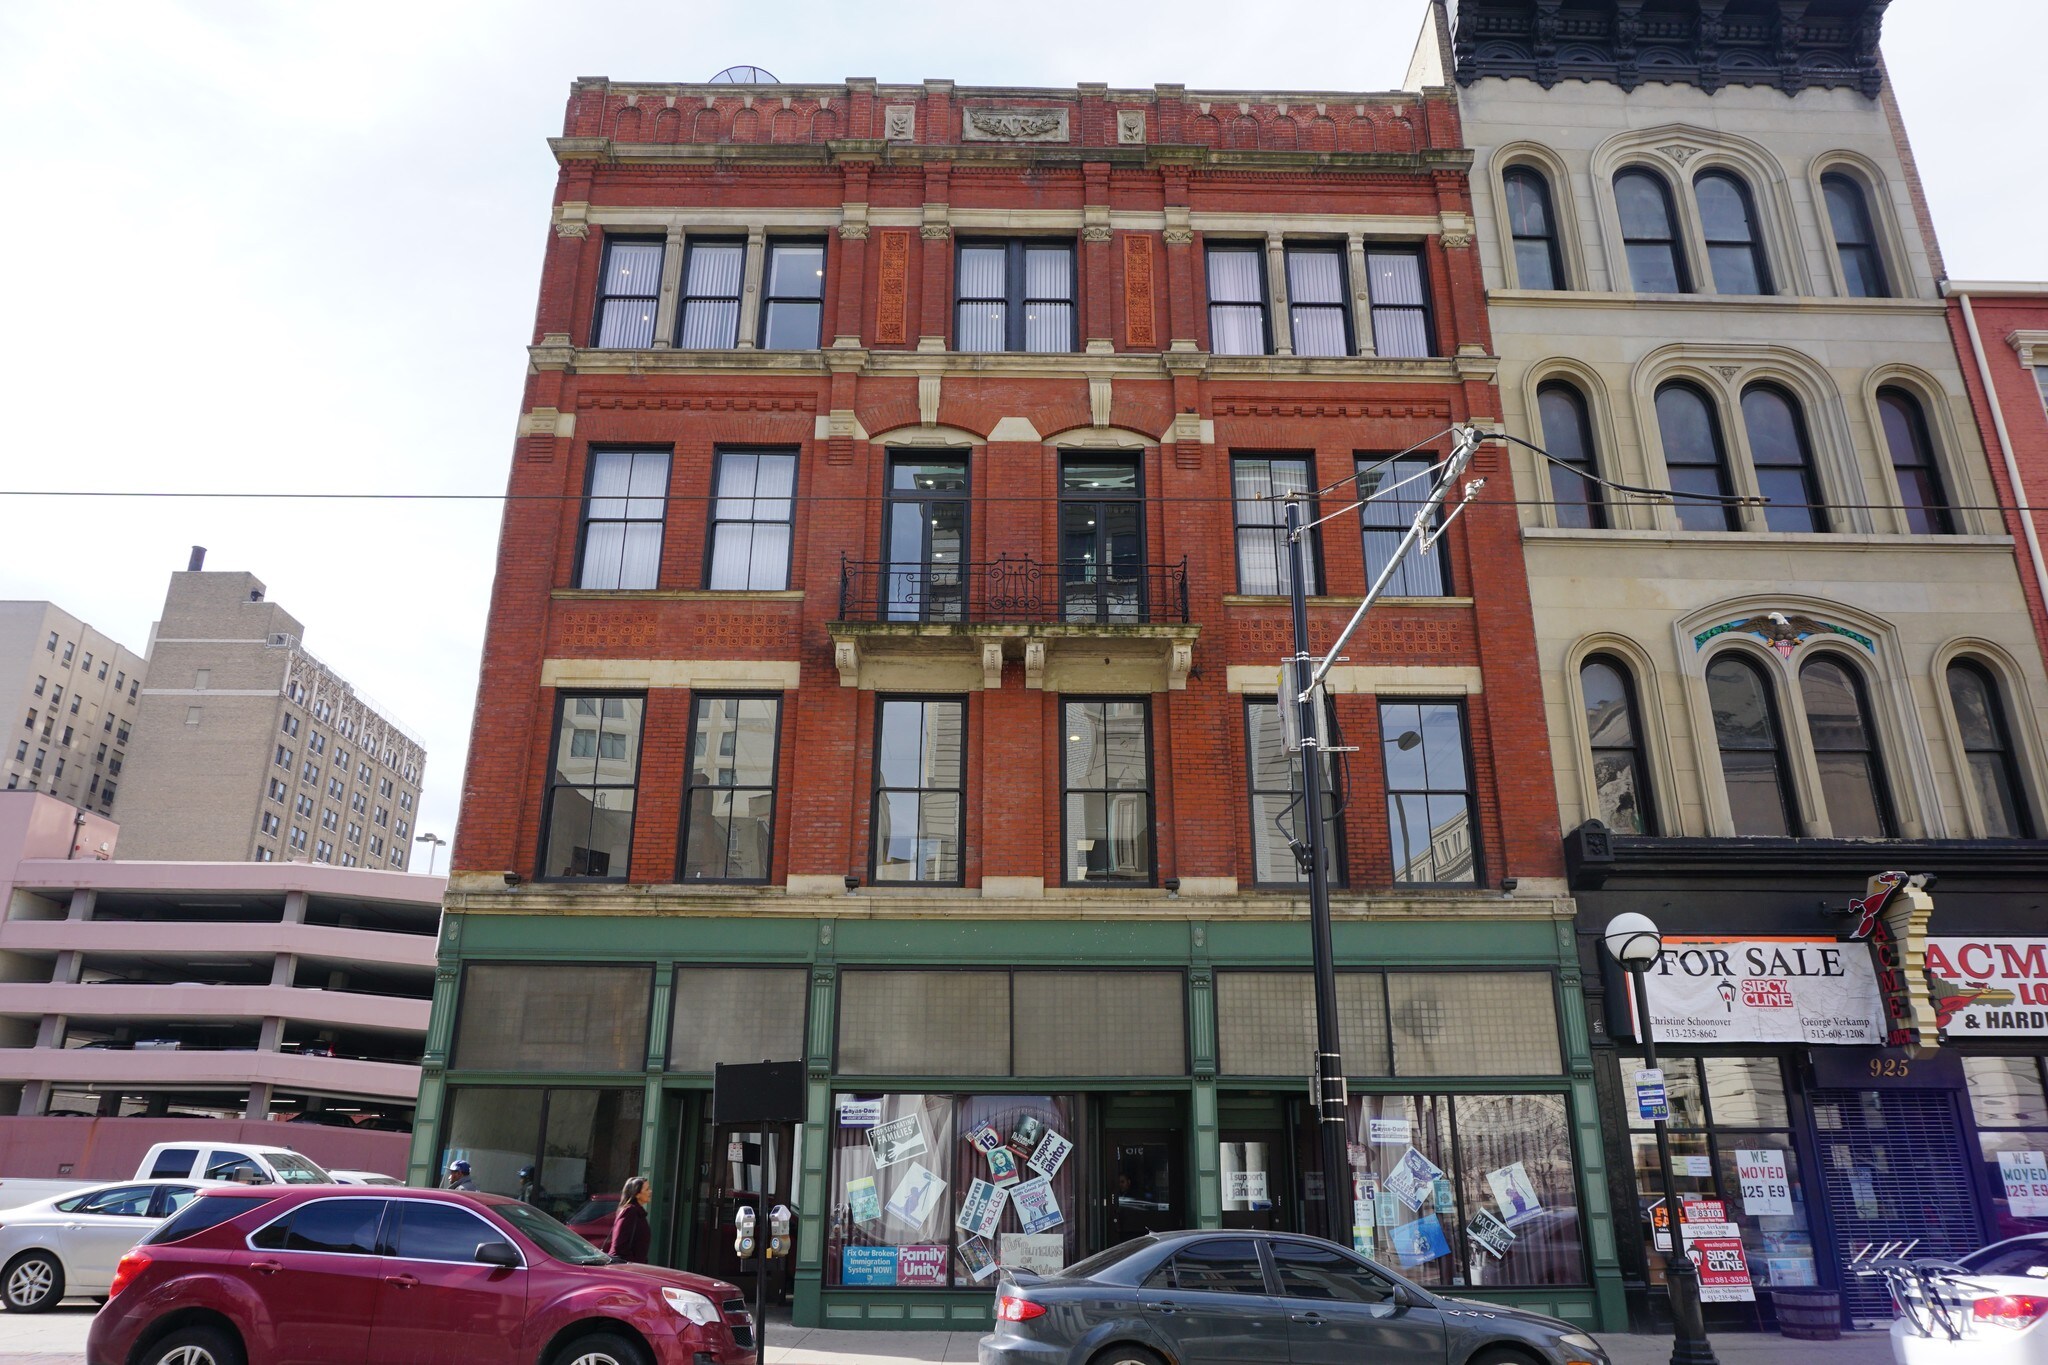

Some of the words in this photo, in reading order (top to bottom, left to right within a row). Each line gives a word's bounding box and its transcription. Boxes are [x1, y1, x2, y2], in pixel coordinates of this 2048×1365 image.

[1657, 949, 1736, 976] FOR
[1746, 948, 1845, 977] SALE
[1875, 920, 1903, 1018] ACME
[1742, 979, 1787, 993] SIBCY
[1742, 993, 1793, 1007] CLINE
[1687, 1017, 1731, 1026] Schoonover
[1802, 1017, 1831, 1028] George
[1833, 1017, 1870, 1028] Verkamp
[1965, 1014, 1980, 1029] &
[1986, 1011, 2048, 1029] HARD
[1666, 1029, 1717, 1038] 513-235-8662
[1811, 1029, 1865, 1039] 513-608-1208
[1870, 1058, 1909, 1077] 925
[1653, 1106, 1666, 1114] 513
[870, 1128, 883, 1138] STOP
[884, 1118, 915, 1133] SEPARATING
[877, 1126, 914, 1145] FAMILIES
[979, 1133, 997, 1150] 15
[1034, 1133, 1055, 1163] support
[1044, 1141, 1067, 1177] janitor
[1750, 1151, 1768, 1163] WE
[2012, 1152, 2031, 1164] WE
[1234, 1173, 1263, 1184] support
[1740, 1167, 1784, 1179] MOVED
[2003, 1168, 2047, 1181] MOVED
[1232, 1185, 1264, 1199] janitor
[1359, 1185, 1375, 1200] 15
[1742, 1185, 1764, 1198] 125
[2006, 1184, 2028, 1197] 125
[959, 1182, 983, 1226] Reform
[976, 1199, 988, 1217] not
[979, 1190, 1004, 1235] Raids
[1475, 1214, 1501, 1237] RACIAL
[1477, 1228, 1507, 1251] JUSTICE
[850, 1258, 890, 1266] Immigration
[899, 1248, 945, 1263] Family
[1706, 1250, 1739, 1260] SIBCY
[848, 1266, 871, 1274] System
[873, 1266, 892, 1274] NOW!
[904, 1263, 940, 1277] Unity
[1708, 1261, 1744, 1271] CLINE
[1715, 1275, 1748, 1283] 381-3338
